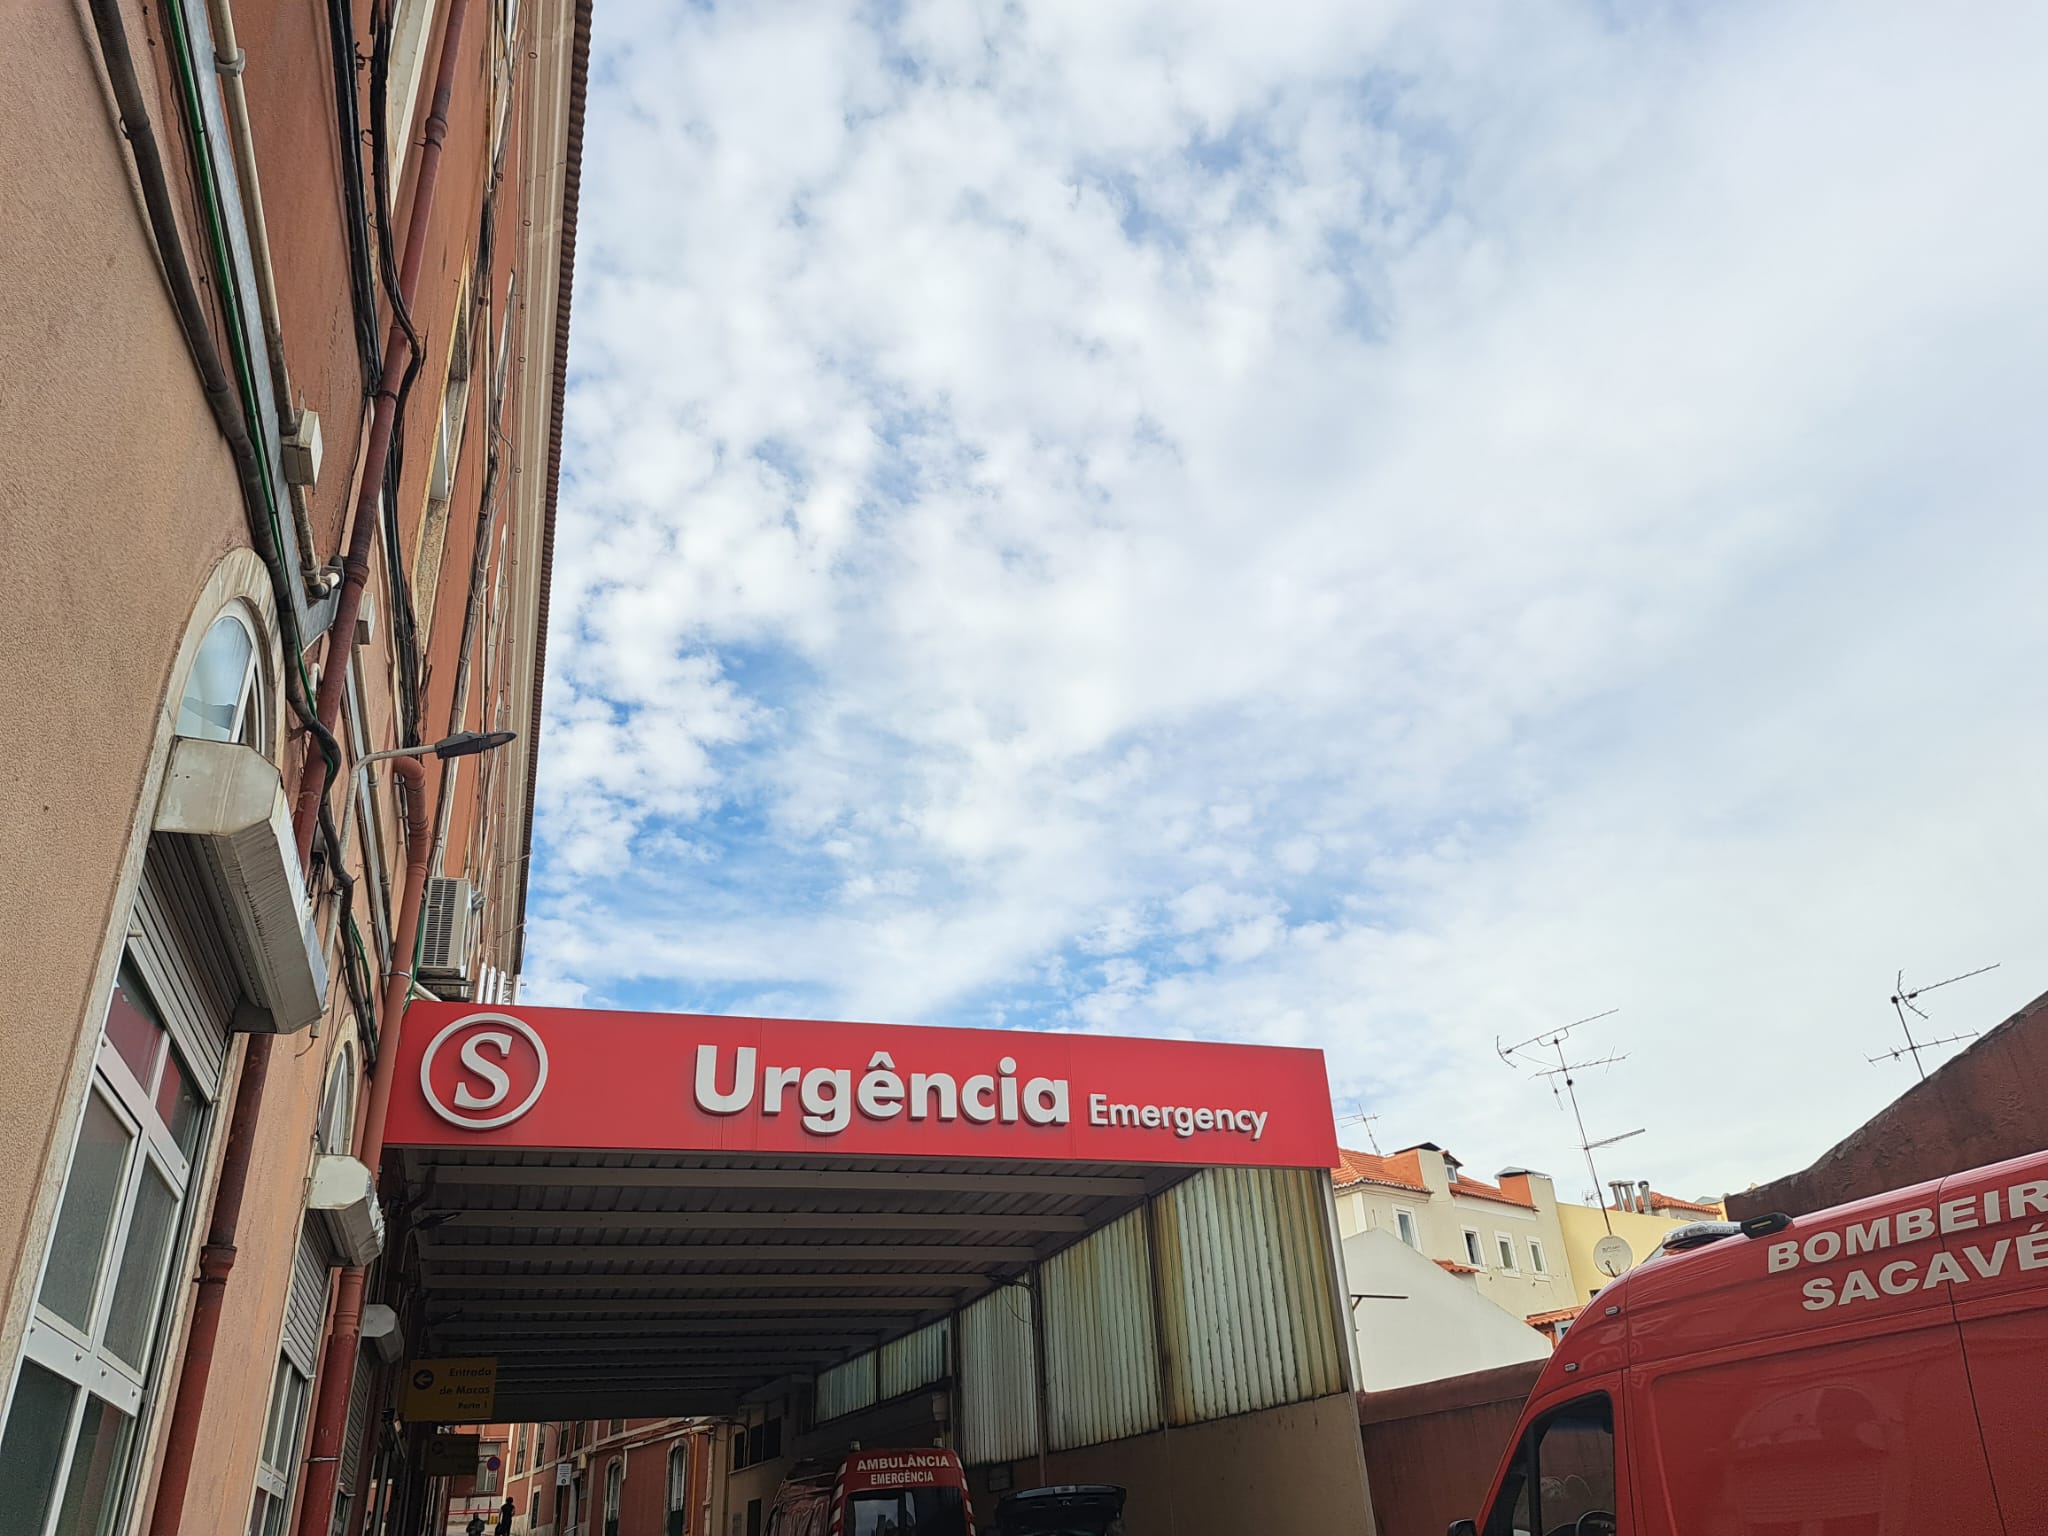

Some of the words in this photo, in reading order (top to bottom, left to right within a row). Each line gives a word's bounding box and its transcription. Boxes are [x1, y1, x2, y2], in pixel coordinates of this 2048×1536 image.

[453, 1032, 513, 1110] S
[694, 1044, 1071, 1135] Urgência
[1088, 1093, 1268, 1139] Emergency
[449, 1367, 491, 1376] Entrada
[439, 1386, 453, 1395] de
[456, 1385, 490, 1395] Macas
[857, 1454, 950, 1471] AMBULÂNCIA
[870, 1470, 934, 1485] EMERGÊNCIA
